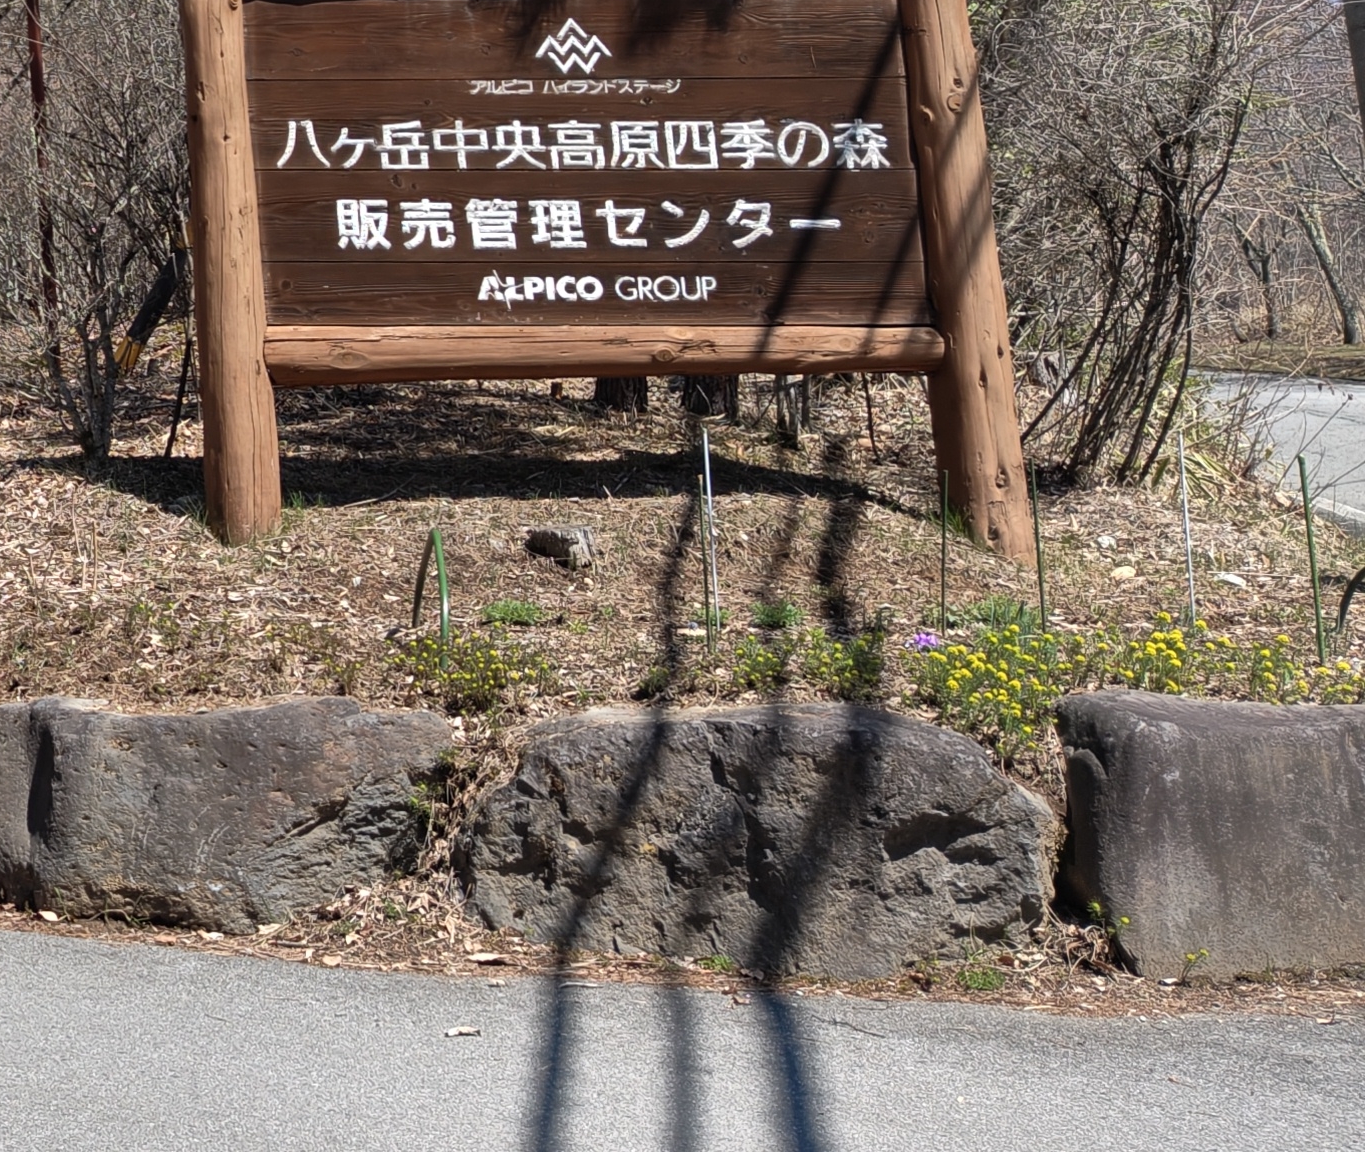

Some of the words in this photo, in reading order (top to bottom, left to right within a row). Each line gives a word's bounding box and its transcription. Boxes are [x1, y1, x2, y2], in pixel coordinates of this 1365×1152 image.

[469, 79, 534, 95] アルピコ
[542, 79, 682, 95] ハイランドステージ
[336, 199, 842, 250] 販売管理センター
[477, 270, 604, 309] ALPICO
[614, 275, 717, 302] GROUP
